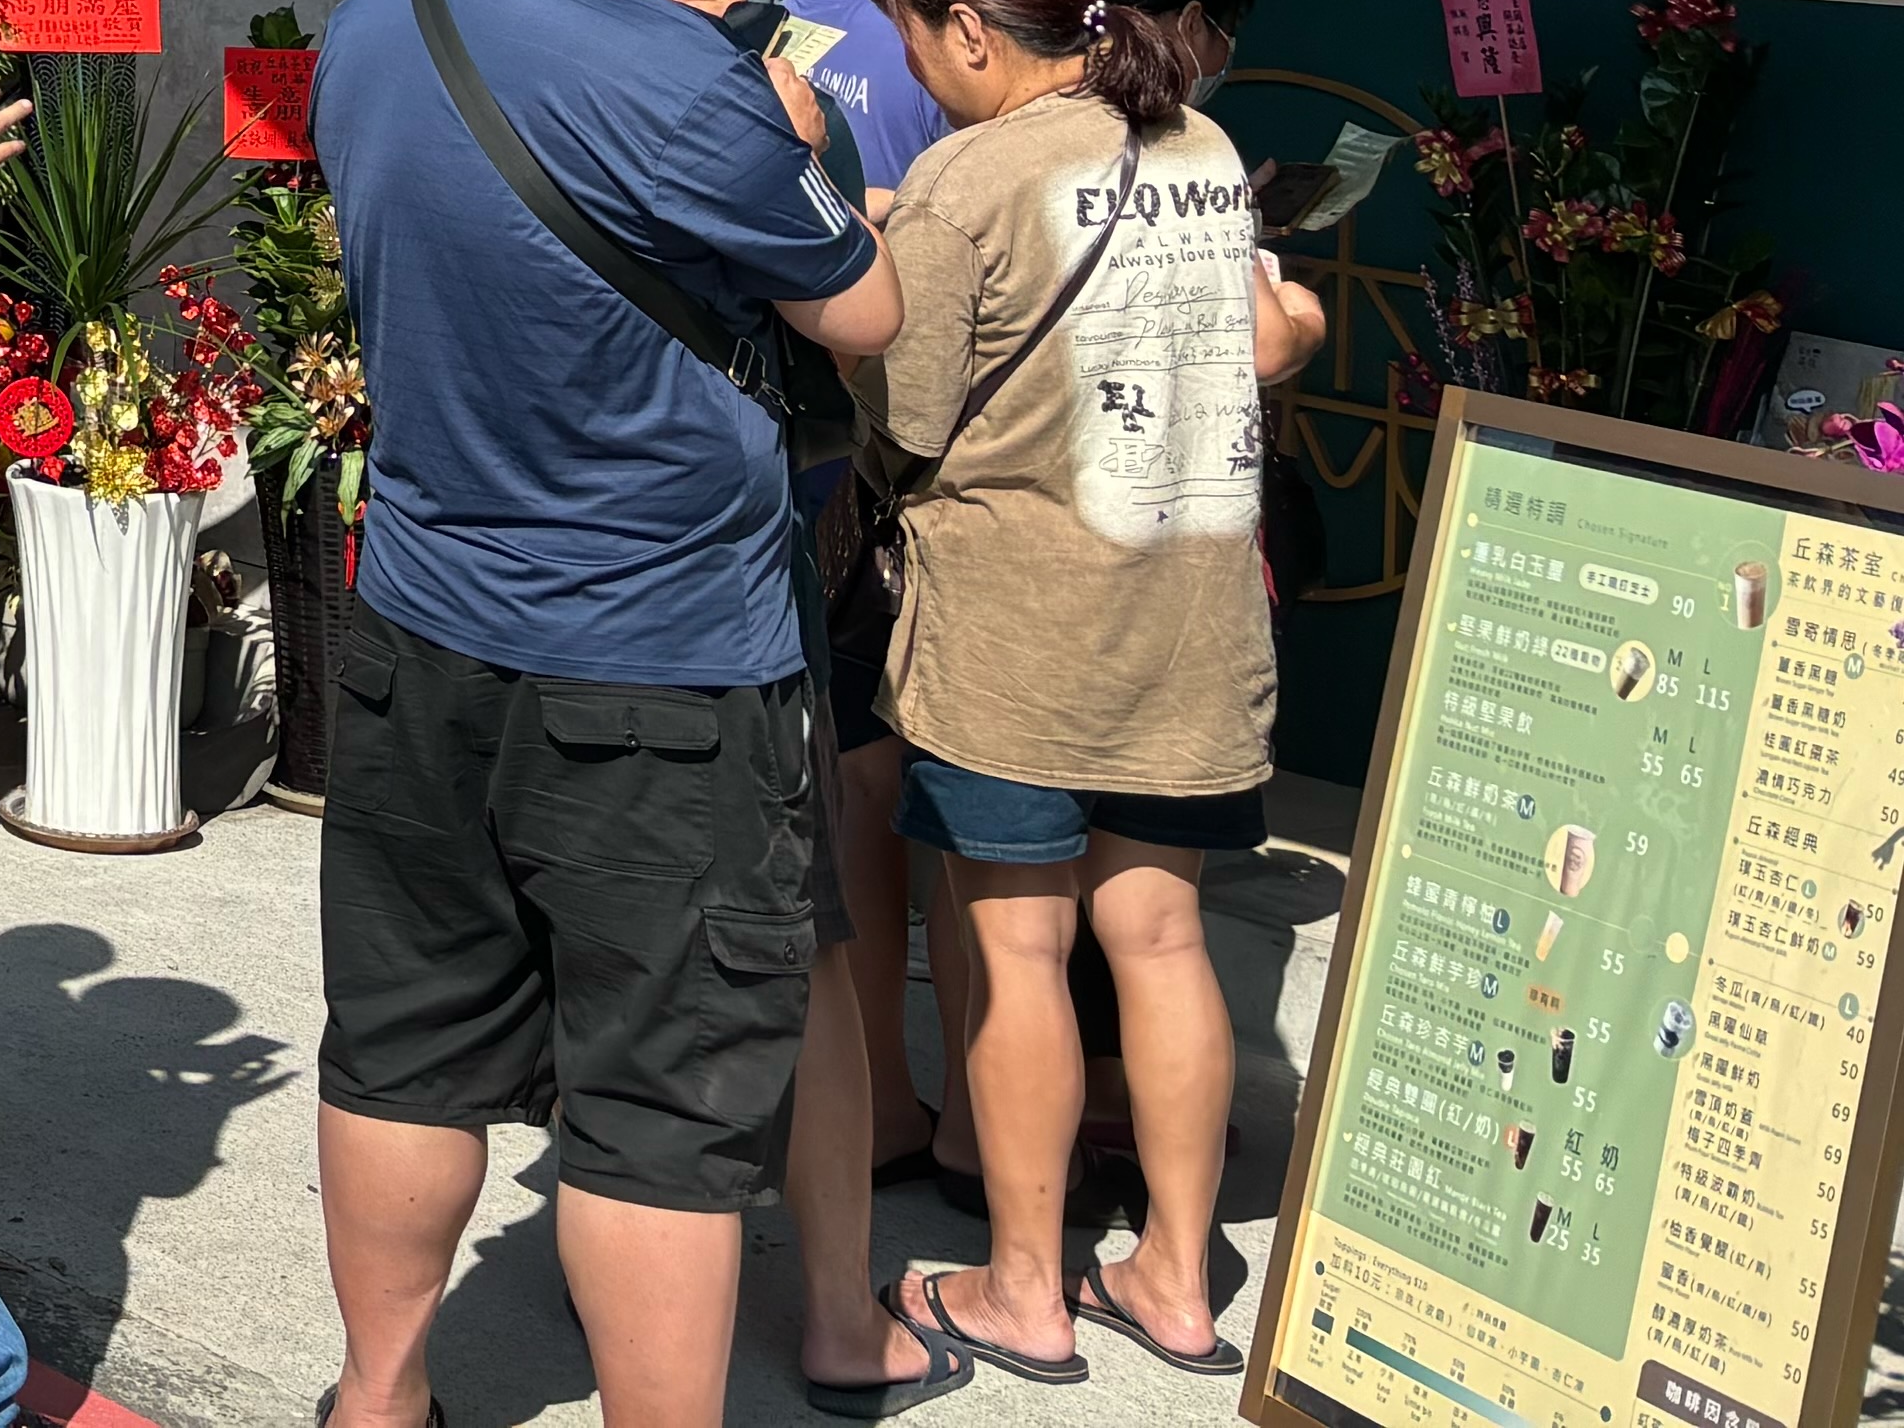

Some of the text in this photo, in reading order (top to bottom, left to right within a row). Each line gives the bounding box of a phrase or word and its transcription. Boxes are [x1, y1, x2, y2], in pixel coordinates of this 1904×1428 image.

[1108, 252, 1175, 270] Always
[1180, 248, 1216, 263] love
[1792, 538, 1883, 577] 丘森茶室
[1671, 595, 1695, 619] 90
[1668, 648, 1683, 667] M
[1656, 674, 1731, 711] 85 115
[1653, 727, 1668, 744] M
[1641, 753, 1704, 787] 55 65
[1755, 768, 1832, 806] 濃情巧克力
[1880, 806, 1899, 824] 50
[1626, 832, 1648, 855] 59
[1746, 815, 1818, 853] 丘森經典
[1866, 904, 1884, 922] 50
[1600, 949, 1625, 975] 55
[1856, 950, 1875, 968] 59
[1587, 1017, 1611, 1044] 55
[1846, 1026, 1864, 1044] 40
[1840, 1060, 1859, 1080] 50
[1572, 1087, 1597, 1112] 55
[1831, 1103, 1850, 1122] 69
[1565, 1128, 1619, 1172] 紅 奶
[1824, 1145, 1842, 1165] 69
[1561, 1155, 1615, 1195] 55 65
[1817, 1182, 1835, 1202] 50
[1557, 1208, 1572, 1227] M
[1810, 1219, 1828, 1239] 55
[1546, 1224, 1601, 1265] 25 35
[1799, 1277, 1817, 1298] 55
[1791, 1320, 1809, 1341] 50
[1783, 1363, 1801, 1384] 50
